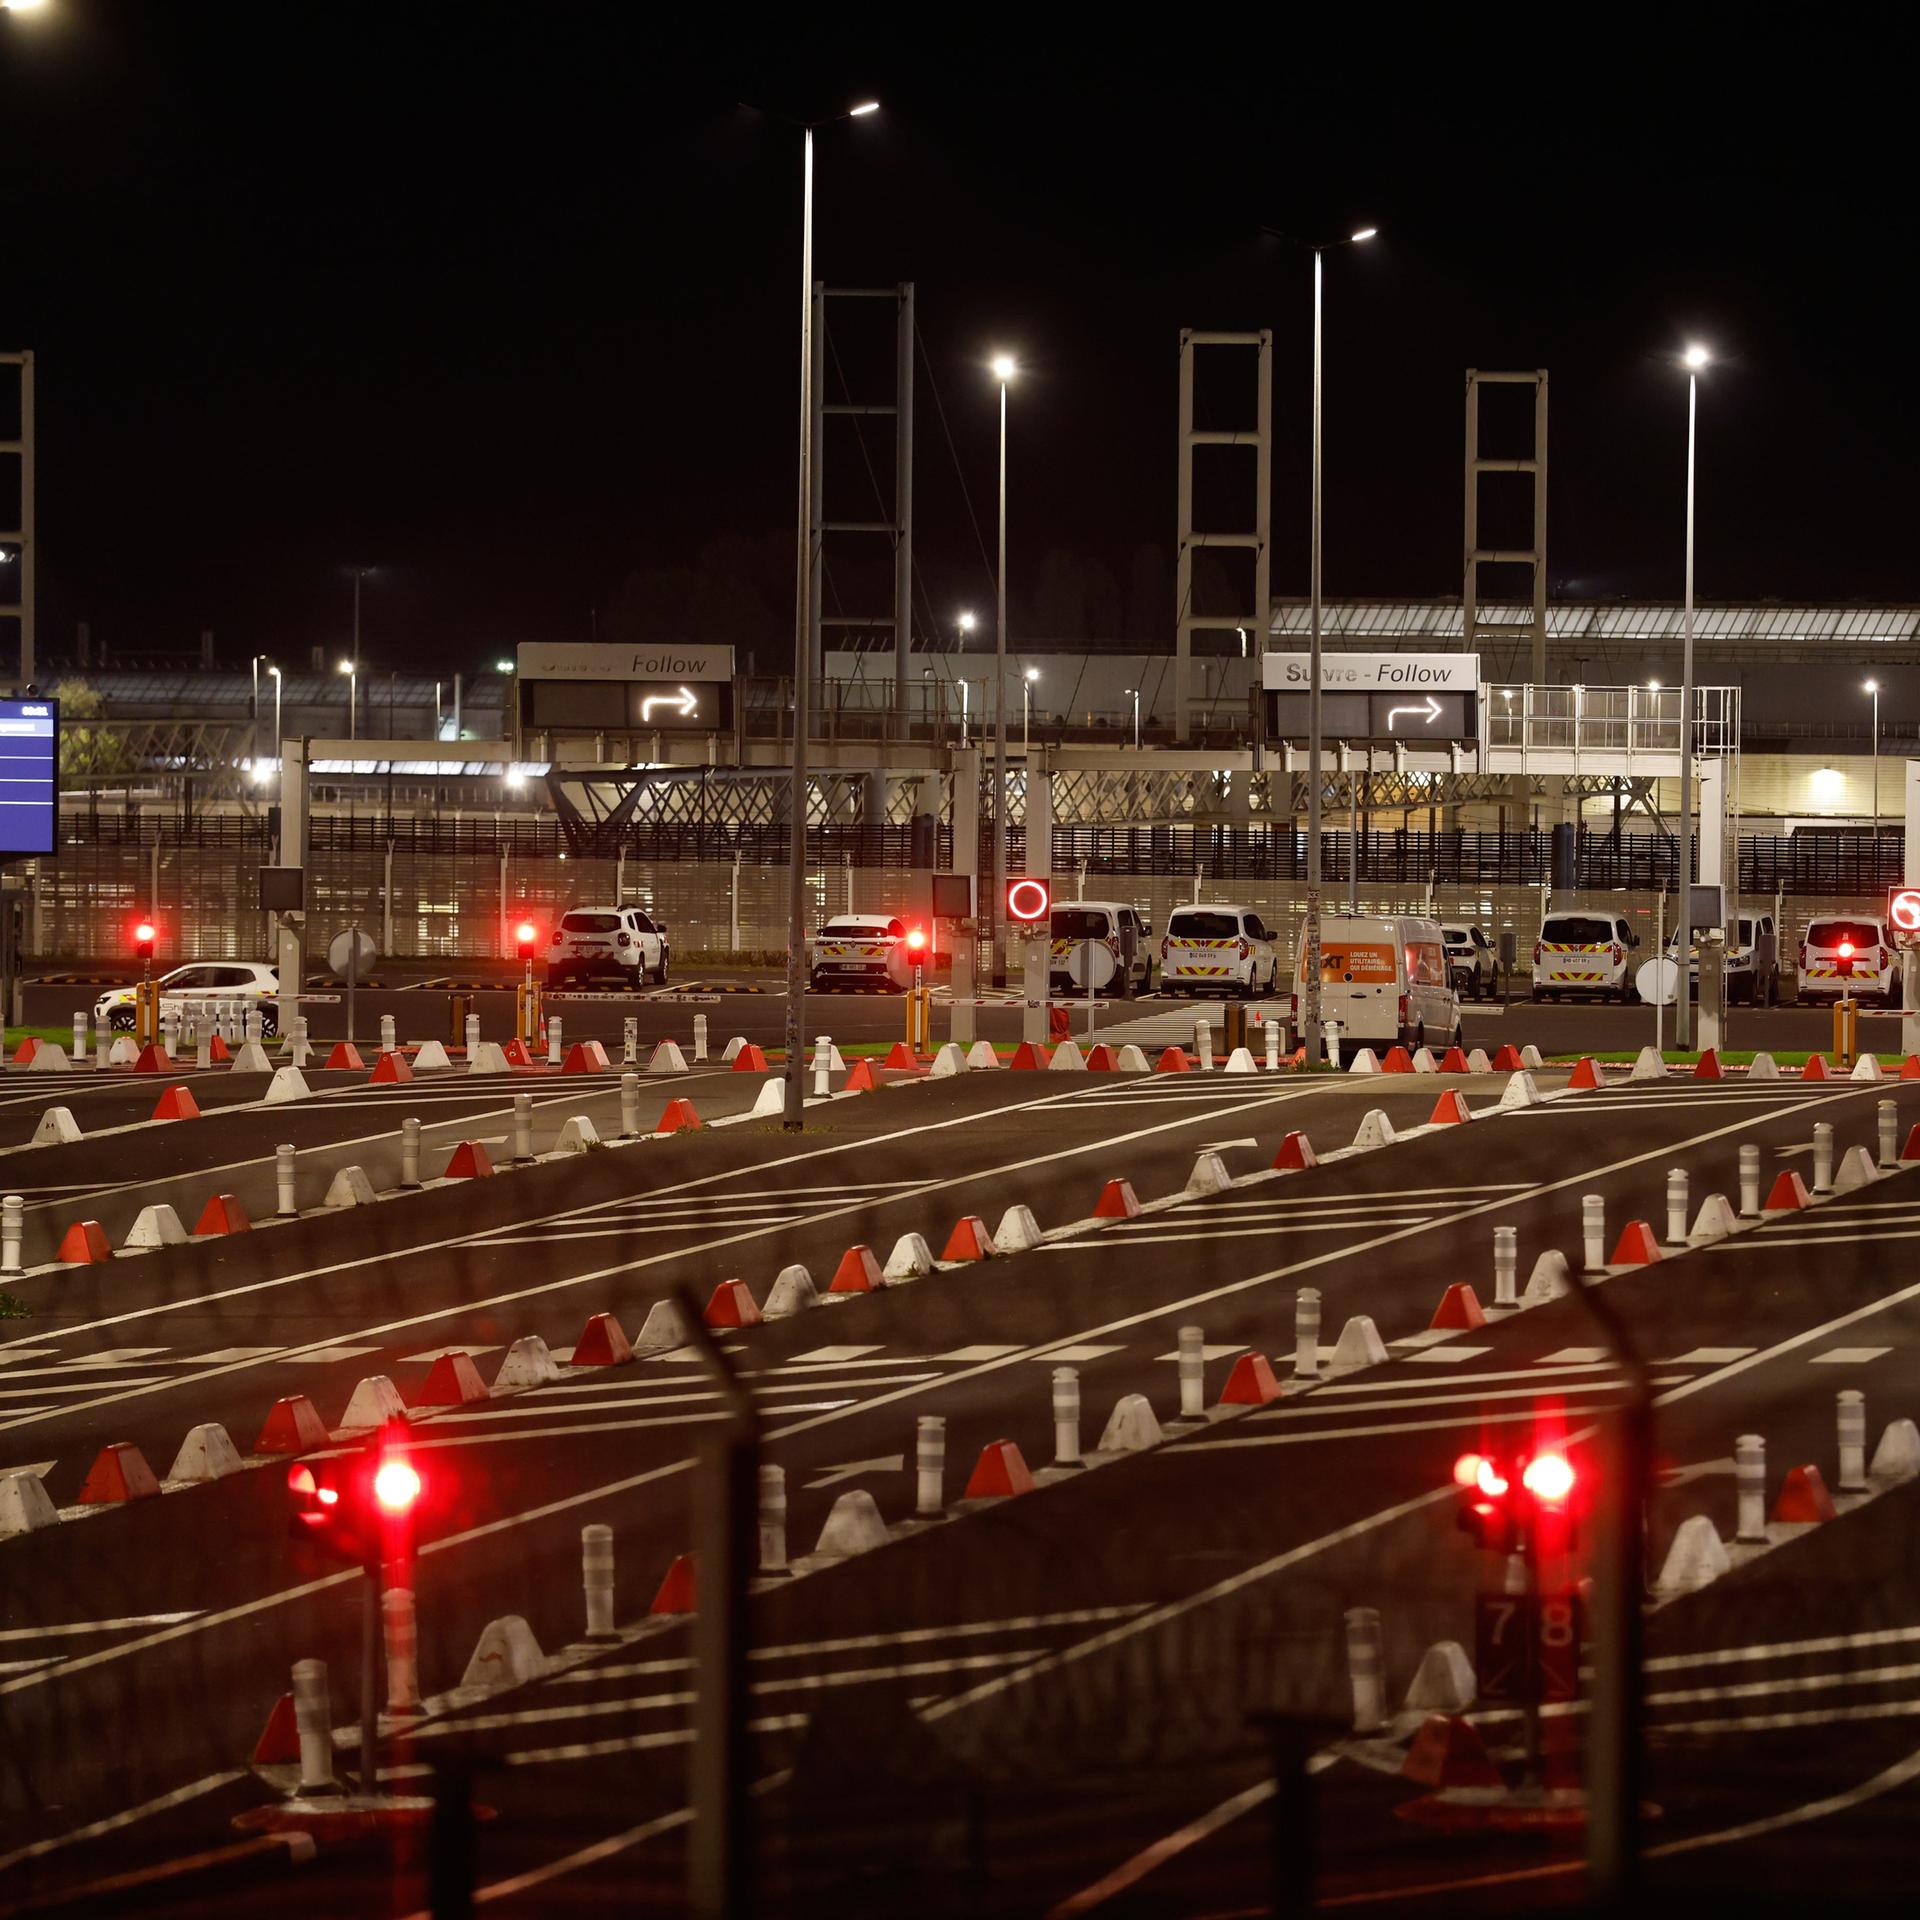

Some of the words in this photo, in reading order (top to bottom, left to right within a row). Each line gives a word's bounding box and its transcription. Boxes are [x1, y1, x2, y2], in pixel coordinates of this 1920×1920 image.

[632, 655, 706, 673] Follow
[1286, 663, 1358, 682] Suvre
[1377, 664, 1451, 682] Follow
[1485, 1601, 1517, 1645] 7
[1540, 1602, 1574, 1647] 8
